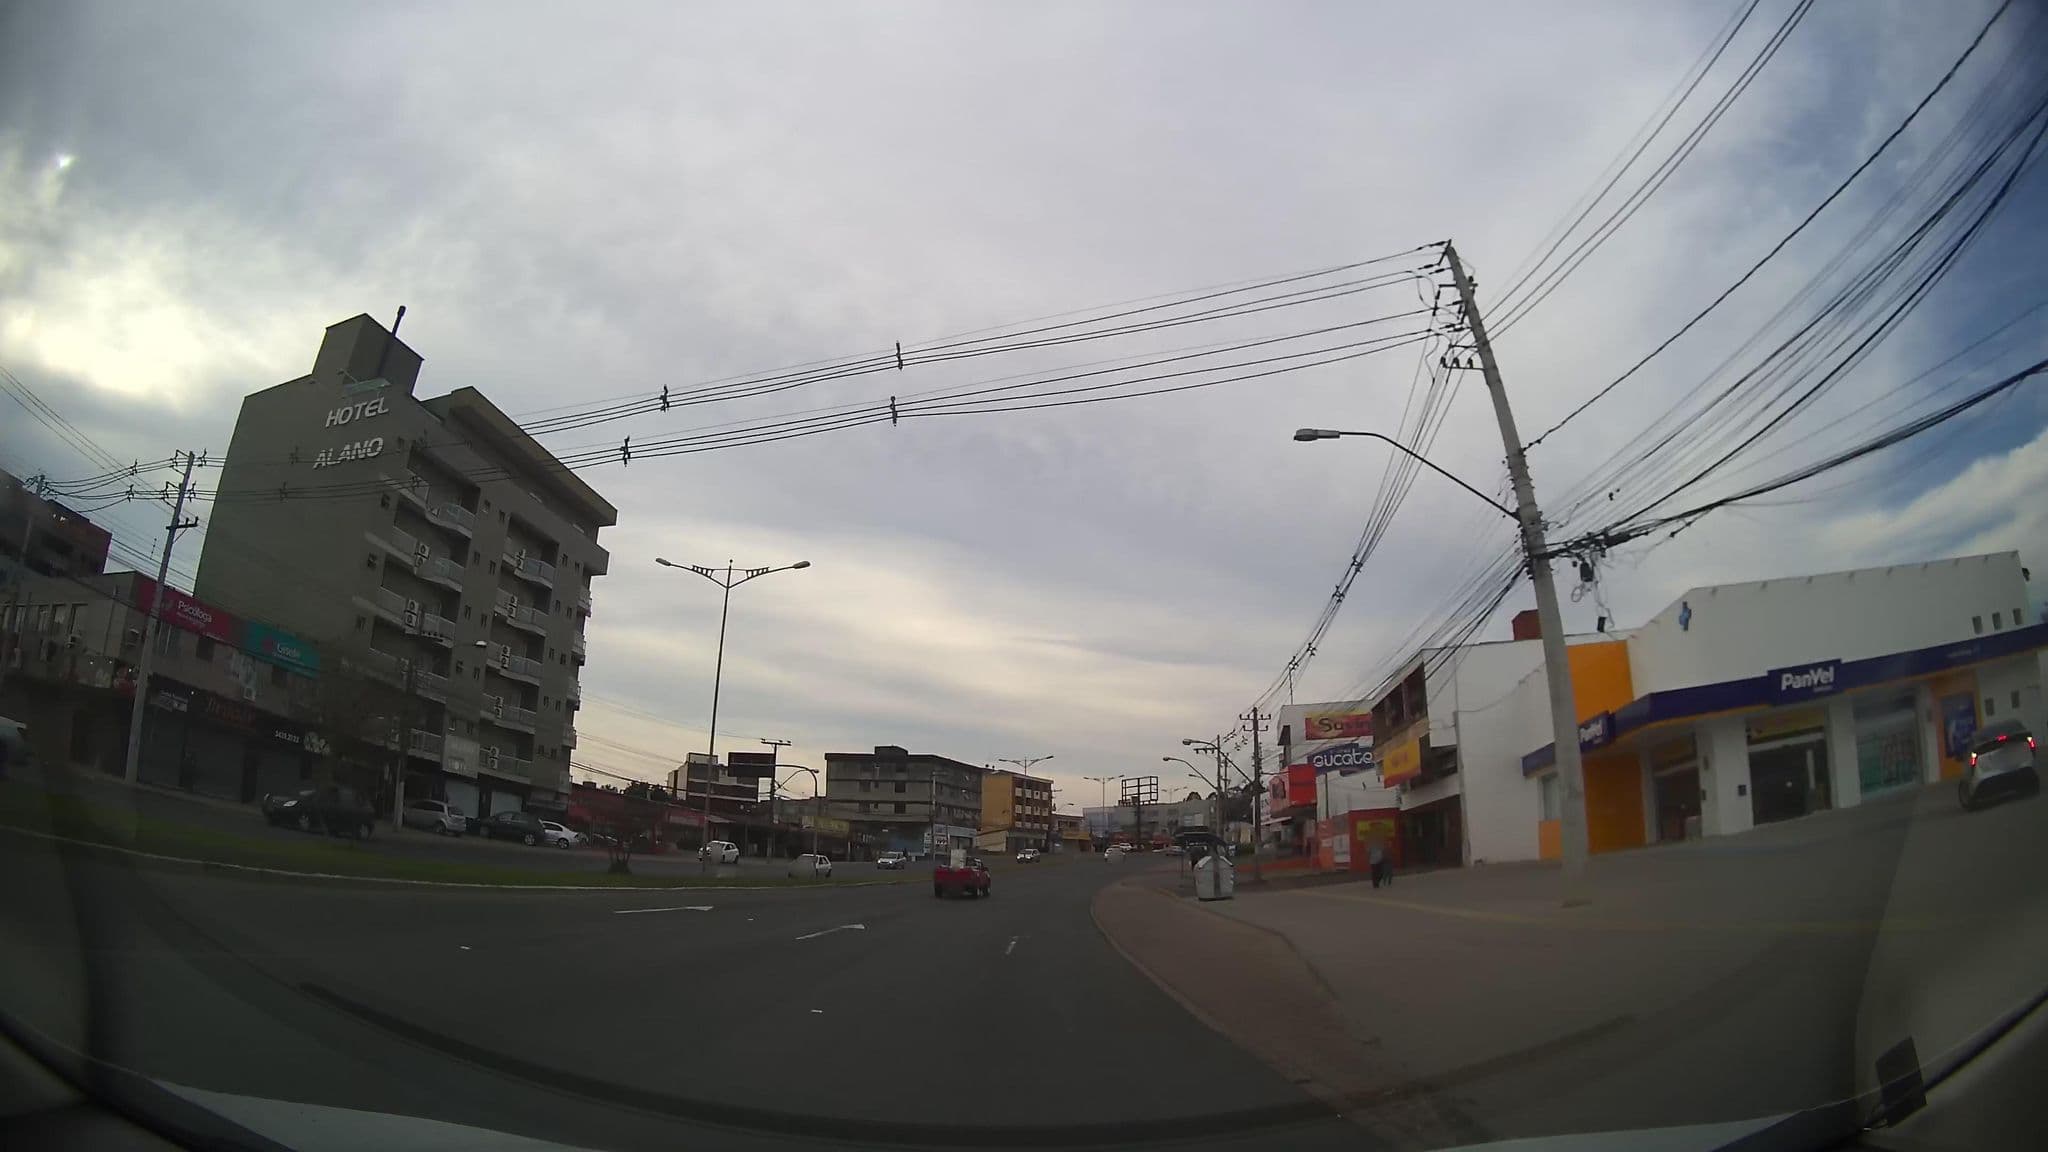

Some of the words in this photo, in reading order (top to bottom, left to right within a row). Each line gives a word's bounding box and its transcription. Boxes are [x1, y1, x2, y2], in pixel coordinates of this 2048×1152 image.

[325, 396, 389, 428] HOTEL
[313, 437, 384, 469] ALANO
[1781, 666, 1835, 691] PanVel
